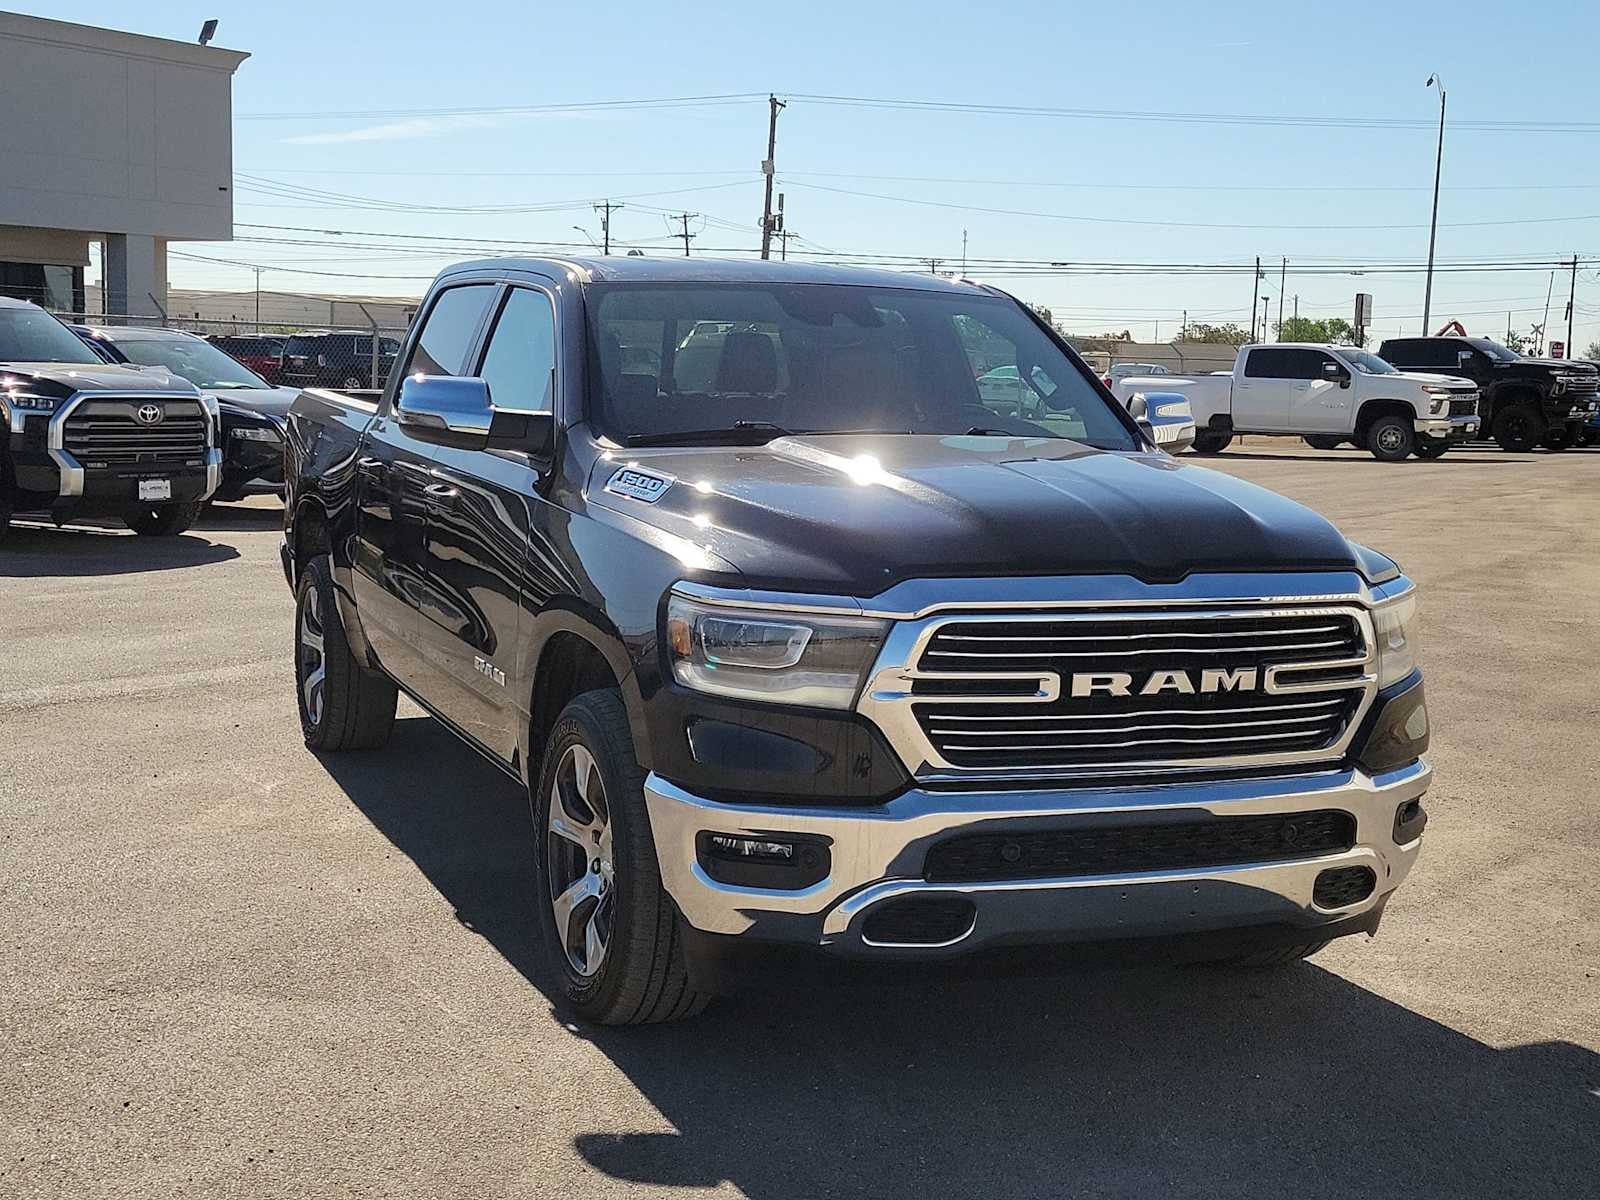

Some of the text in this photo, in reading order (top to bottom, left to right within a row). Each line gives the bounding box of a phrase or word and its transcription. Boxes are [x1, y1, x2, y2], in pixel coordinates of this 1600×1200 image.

[617, 469, 665, 493] 1500
[474, 655, 506, 688] RAM
[1071, 666, 1258, 698] RAM
